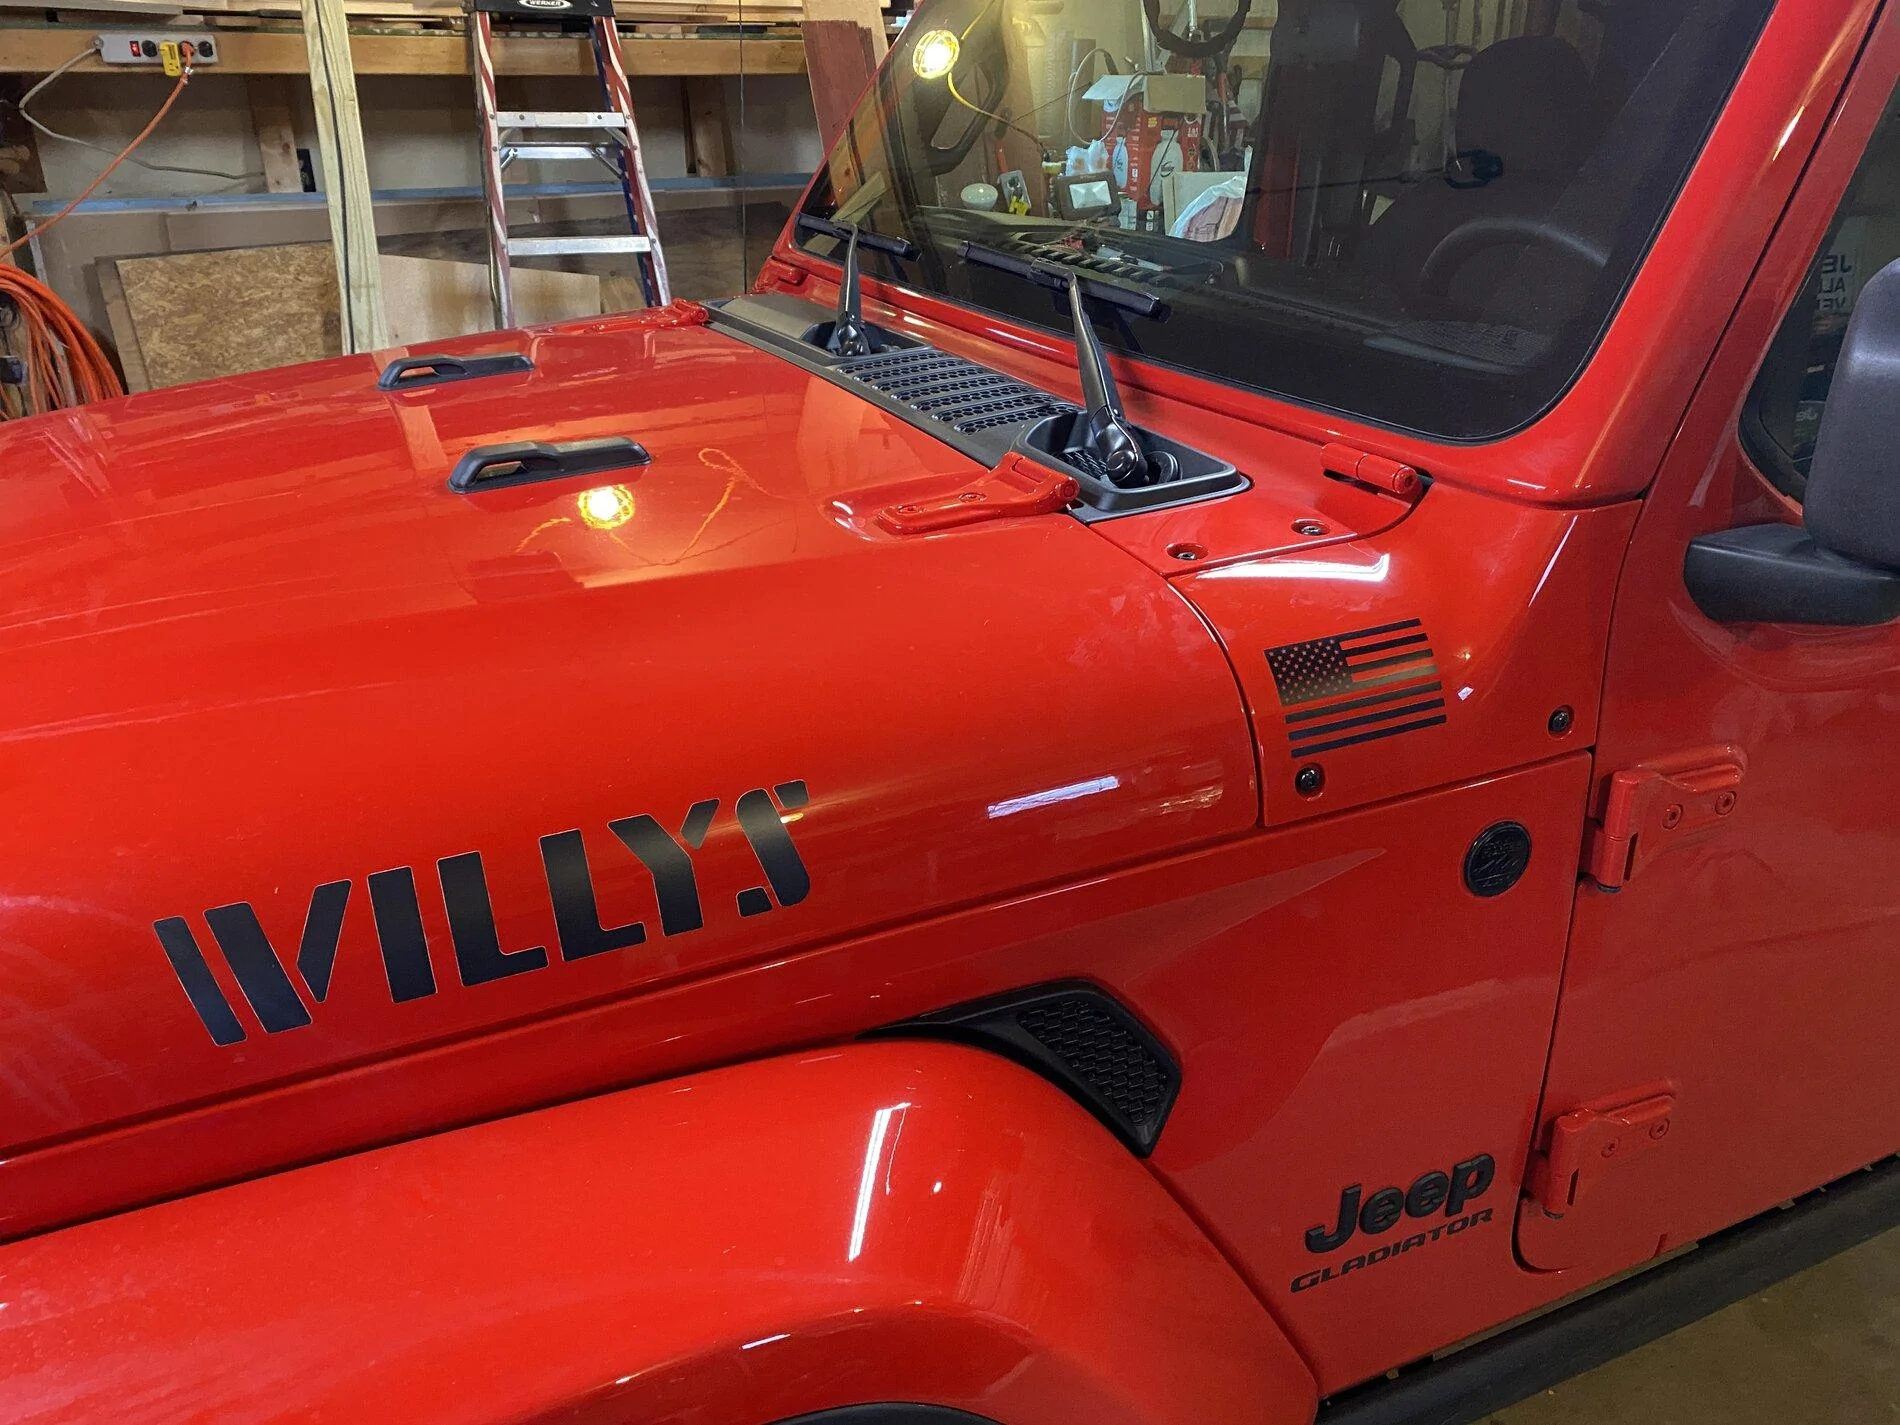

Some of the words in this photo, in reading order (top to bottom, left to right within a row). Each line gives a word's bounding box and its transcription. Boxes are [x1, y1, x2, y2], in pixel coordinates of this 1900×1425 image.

[153, 779, 811, 1047] WILLYS
[1289, 1208, 1494, 1294] GLADIATOR
[1305, 1153, 1496, 1253] Jeep
